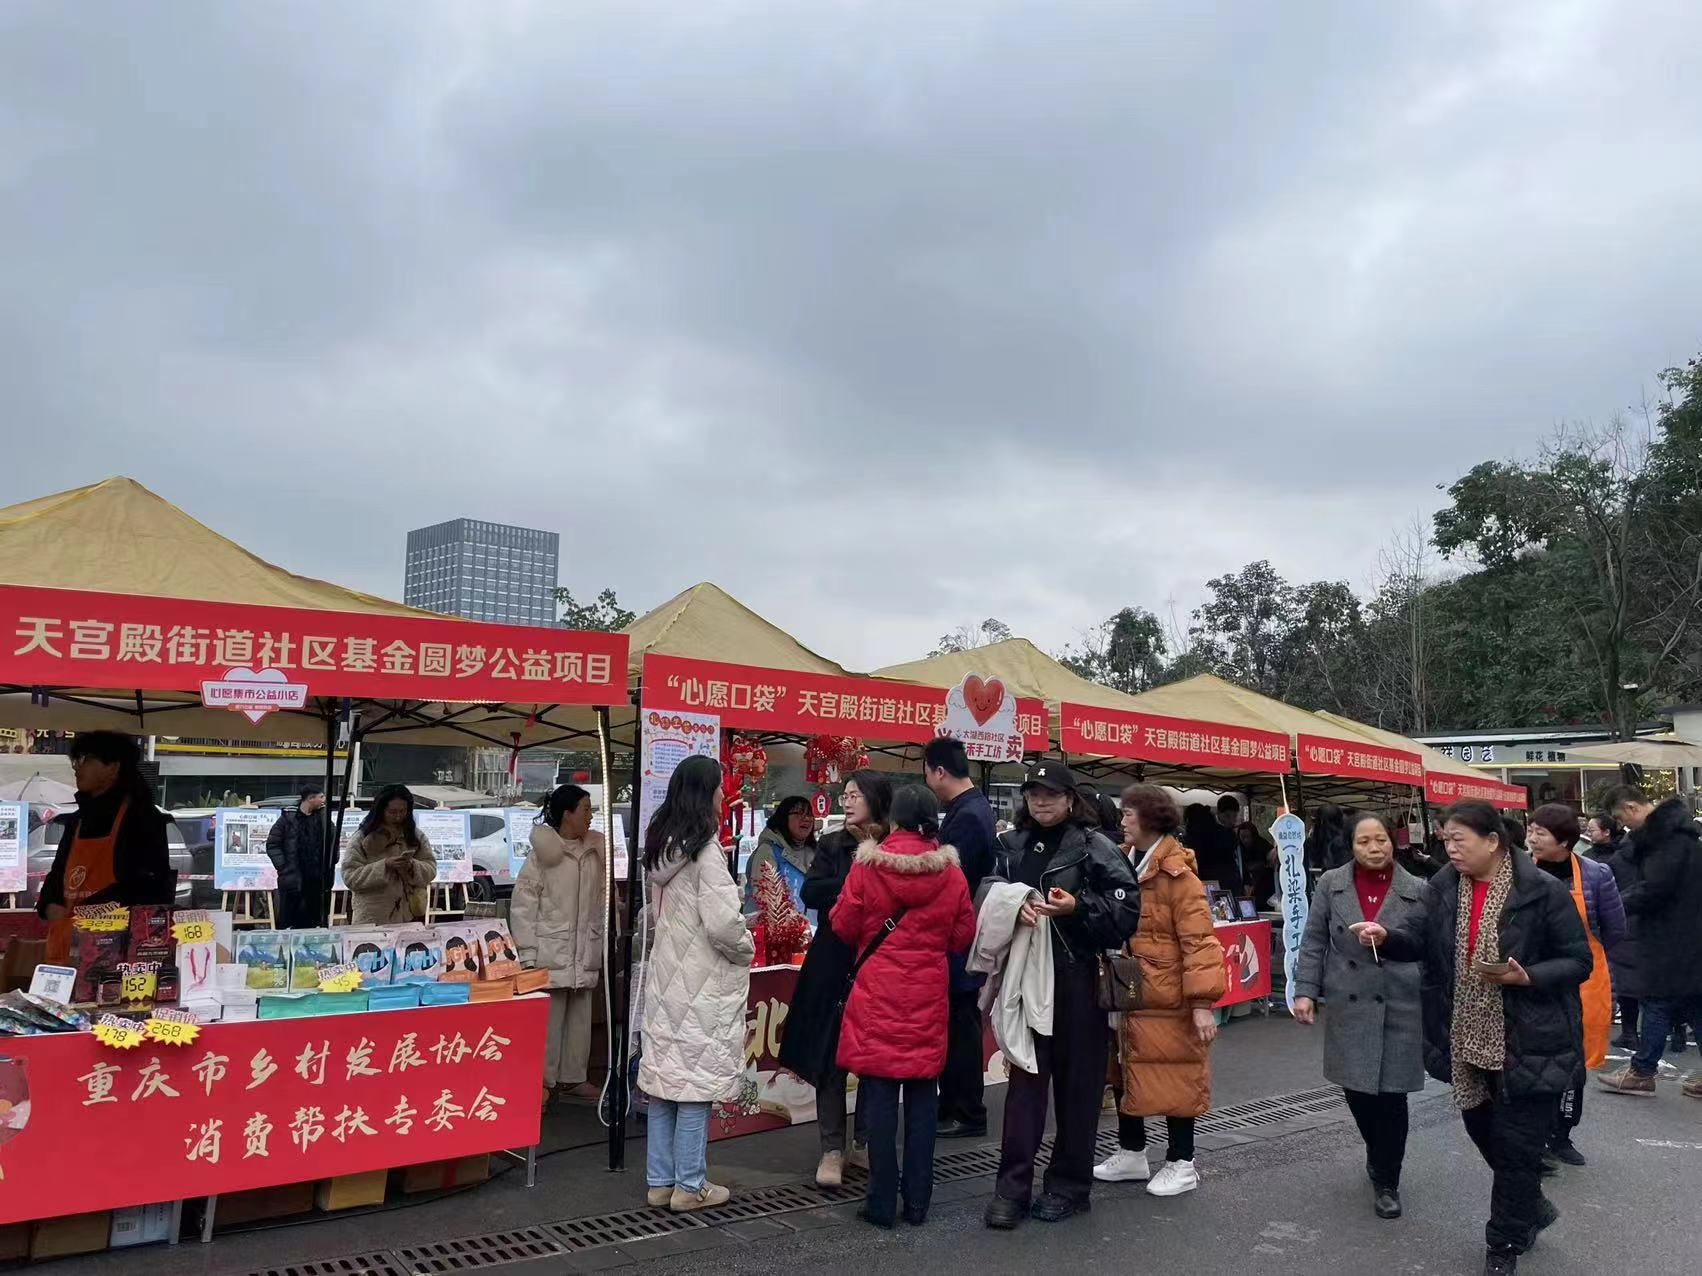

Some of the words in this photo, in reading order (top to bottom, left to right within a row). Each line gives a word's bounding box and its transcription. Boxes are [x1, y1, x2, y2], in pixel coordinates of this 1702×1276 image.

[14, 616, 612, 685] 天宫殿街道社区基金圆梦公益项目
[210, 687, 299, 701] 心愿集市公益小店
[1144, 727, 1287, 762] 天宫殿街道社区基金圆梦公益项目
[184, 924, 203, 940] 168
[125, 977, 147, 992] 152
[104, 1028, 128, 1042] 178
[151, 1022, 182, 1038] 268
[77, 1026, 512, 1107] 重庆市乡村发展协会
[184, 1085, 507, 1165] 消费帮扶专委会
